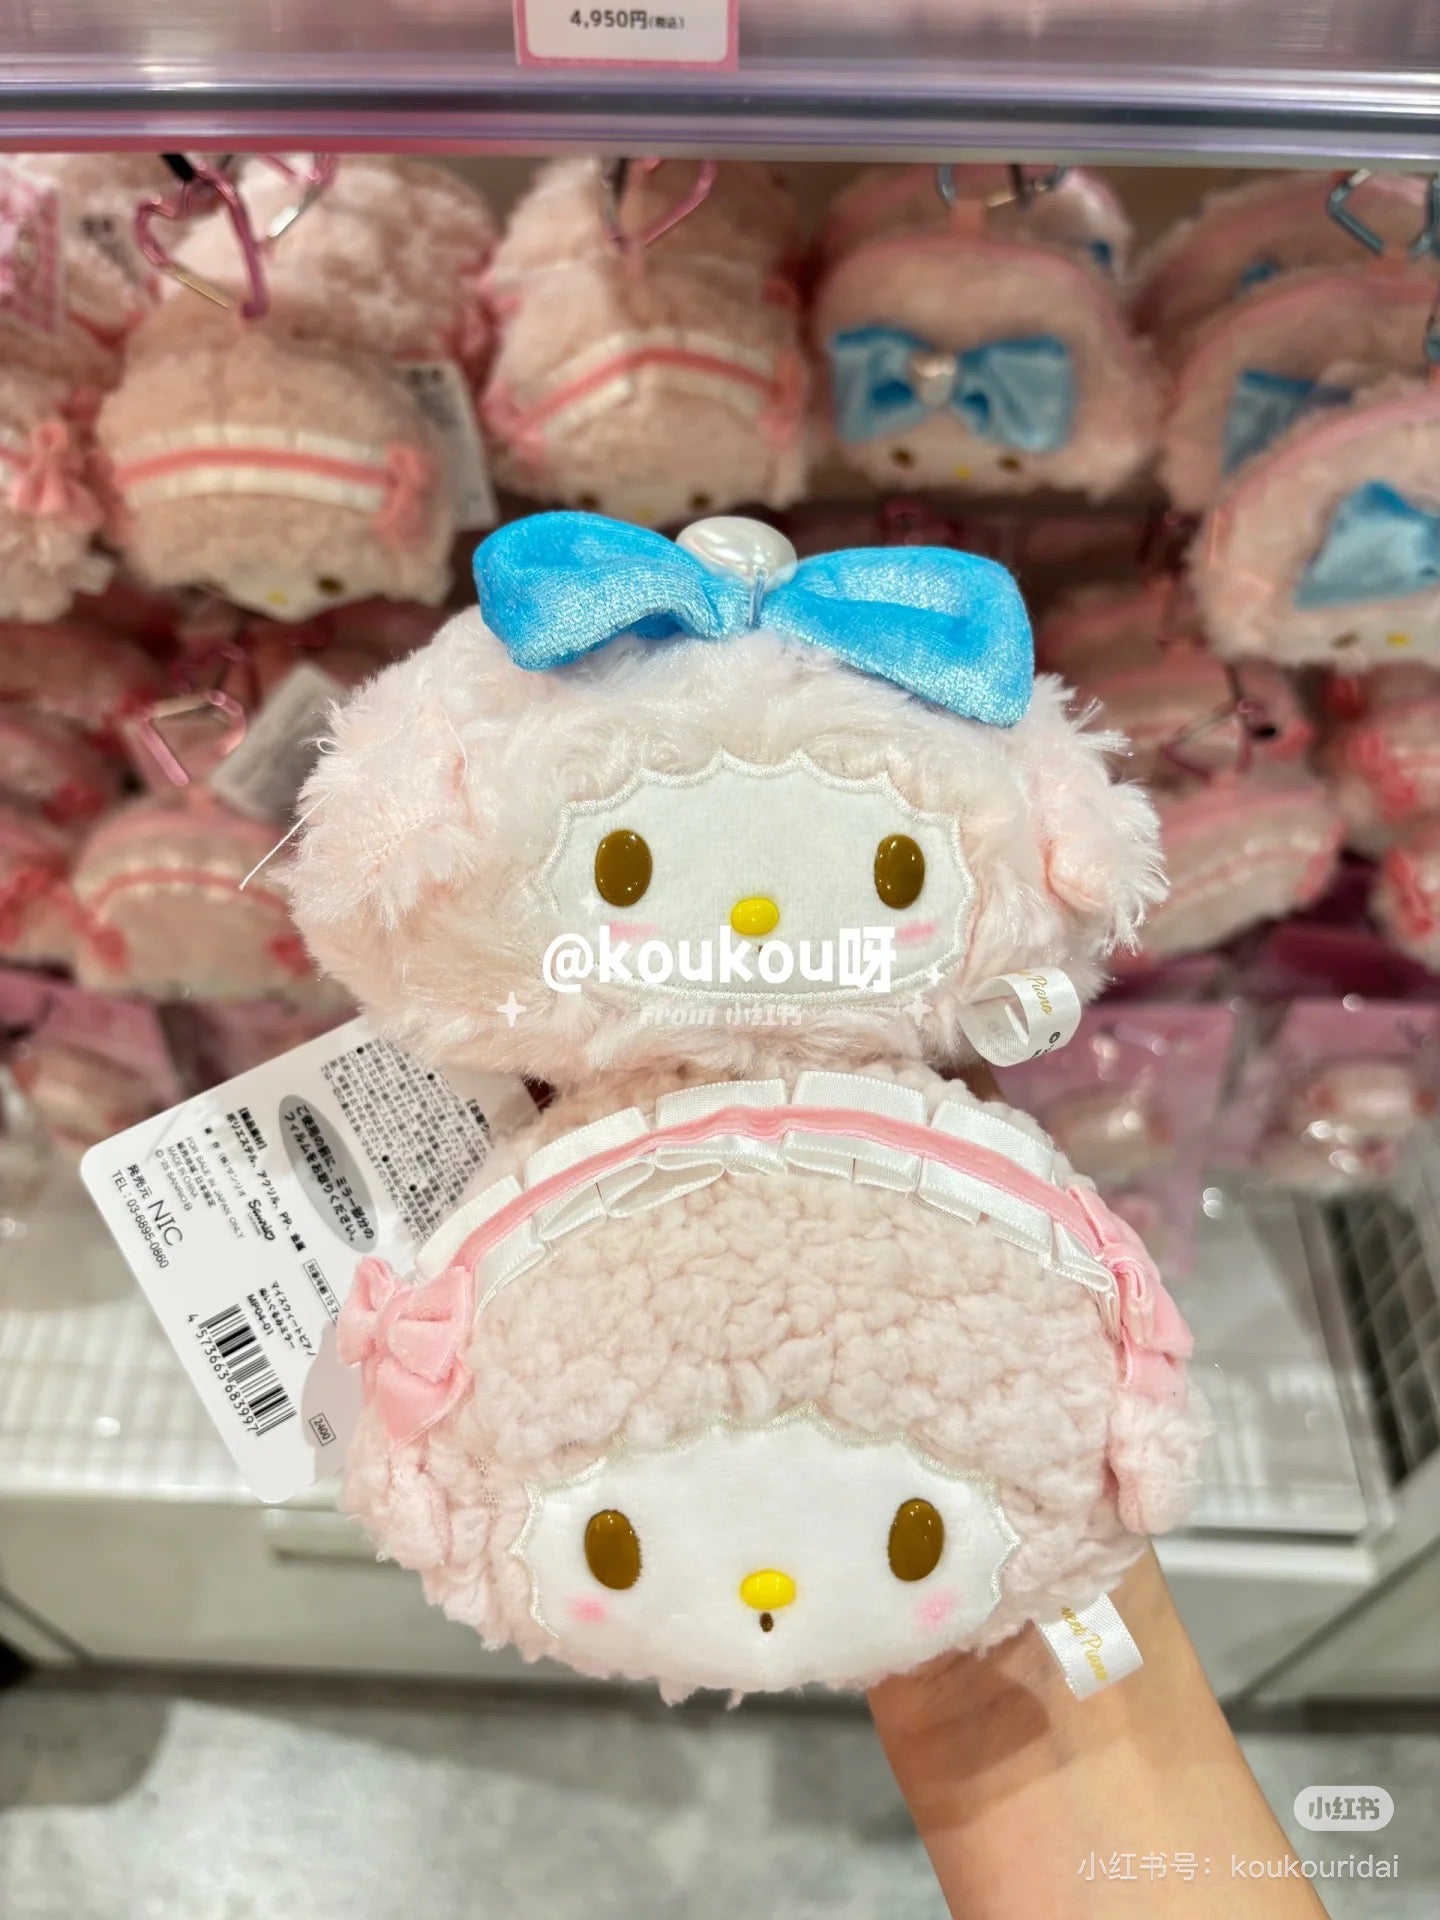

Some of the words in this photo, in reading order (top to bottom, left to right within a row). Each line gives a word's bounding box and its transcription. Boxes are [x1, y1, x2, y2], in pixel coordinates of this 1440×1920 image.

[1027, 975, 1053, 1016] Piano
[148, 1200, 183, 1246] NIC
[314, 1418, 330, 1440] 2400
